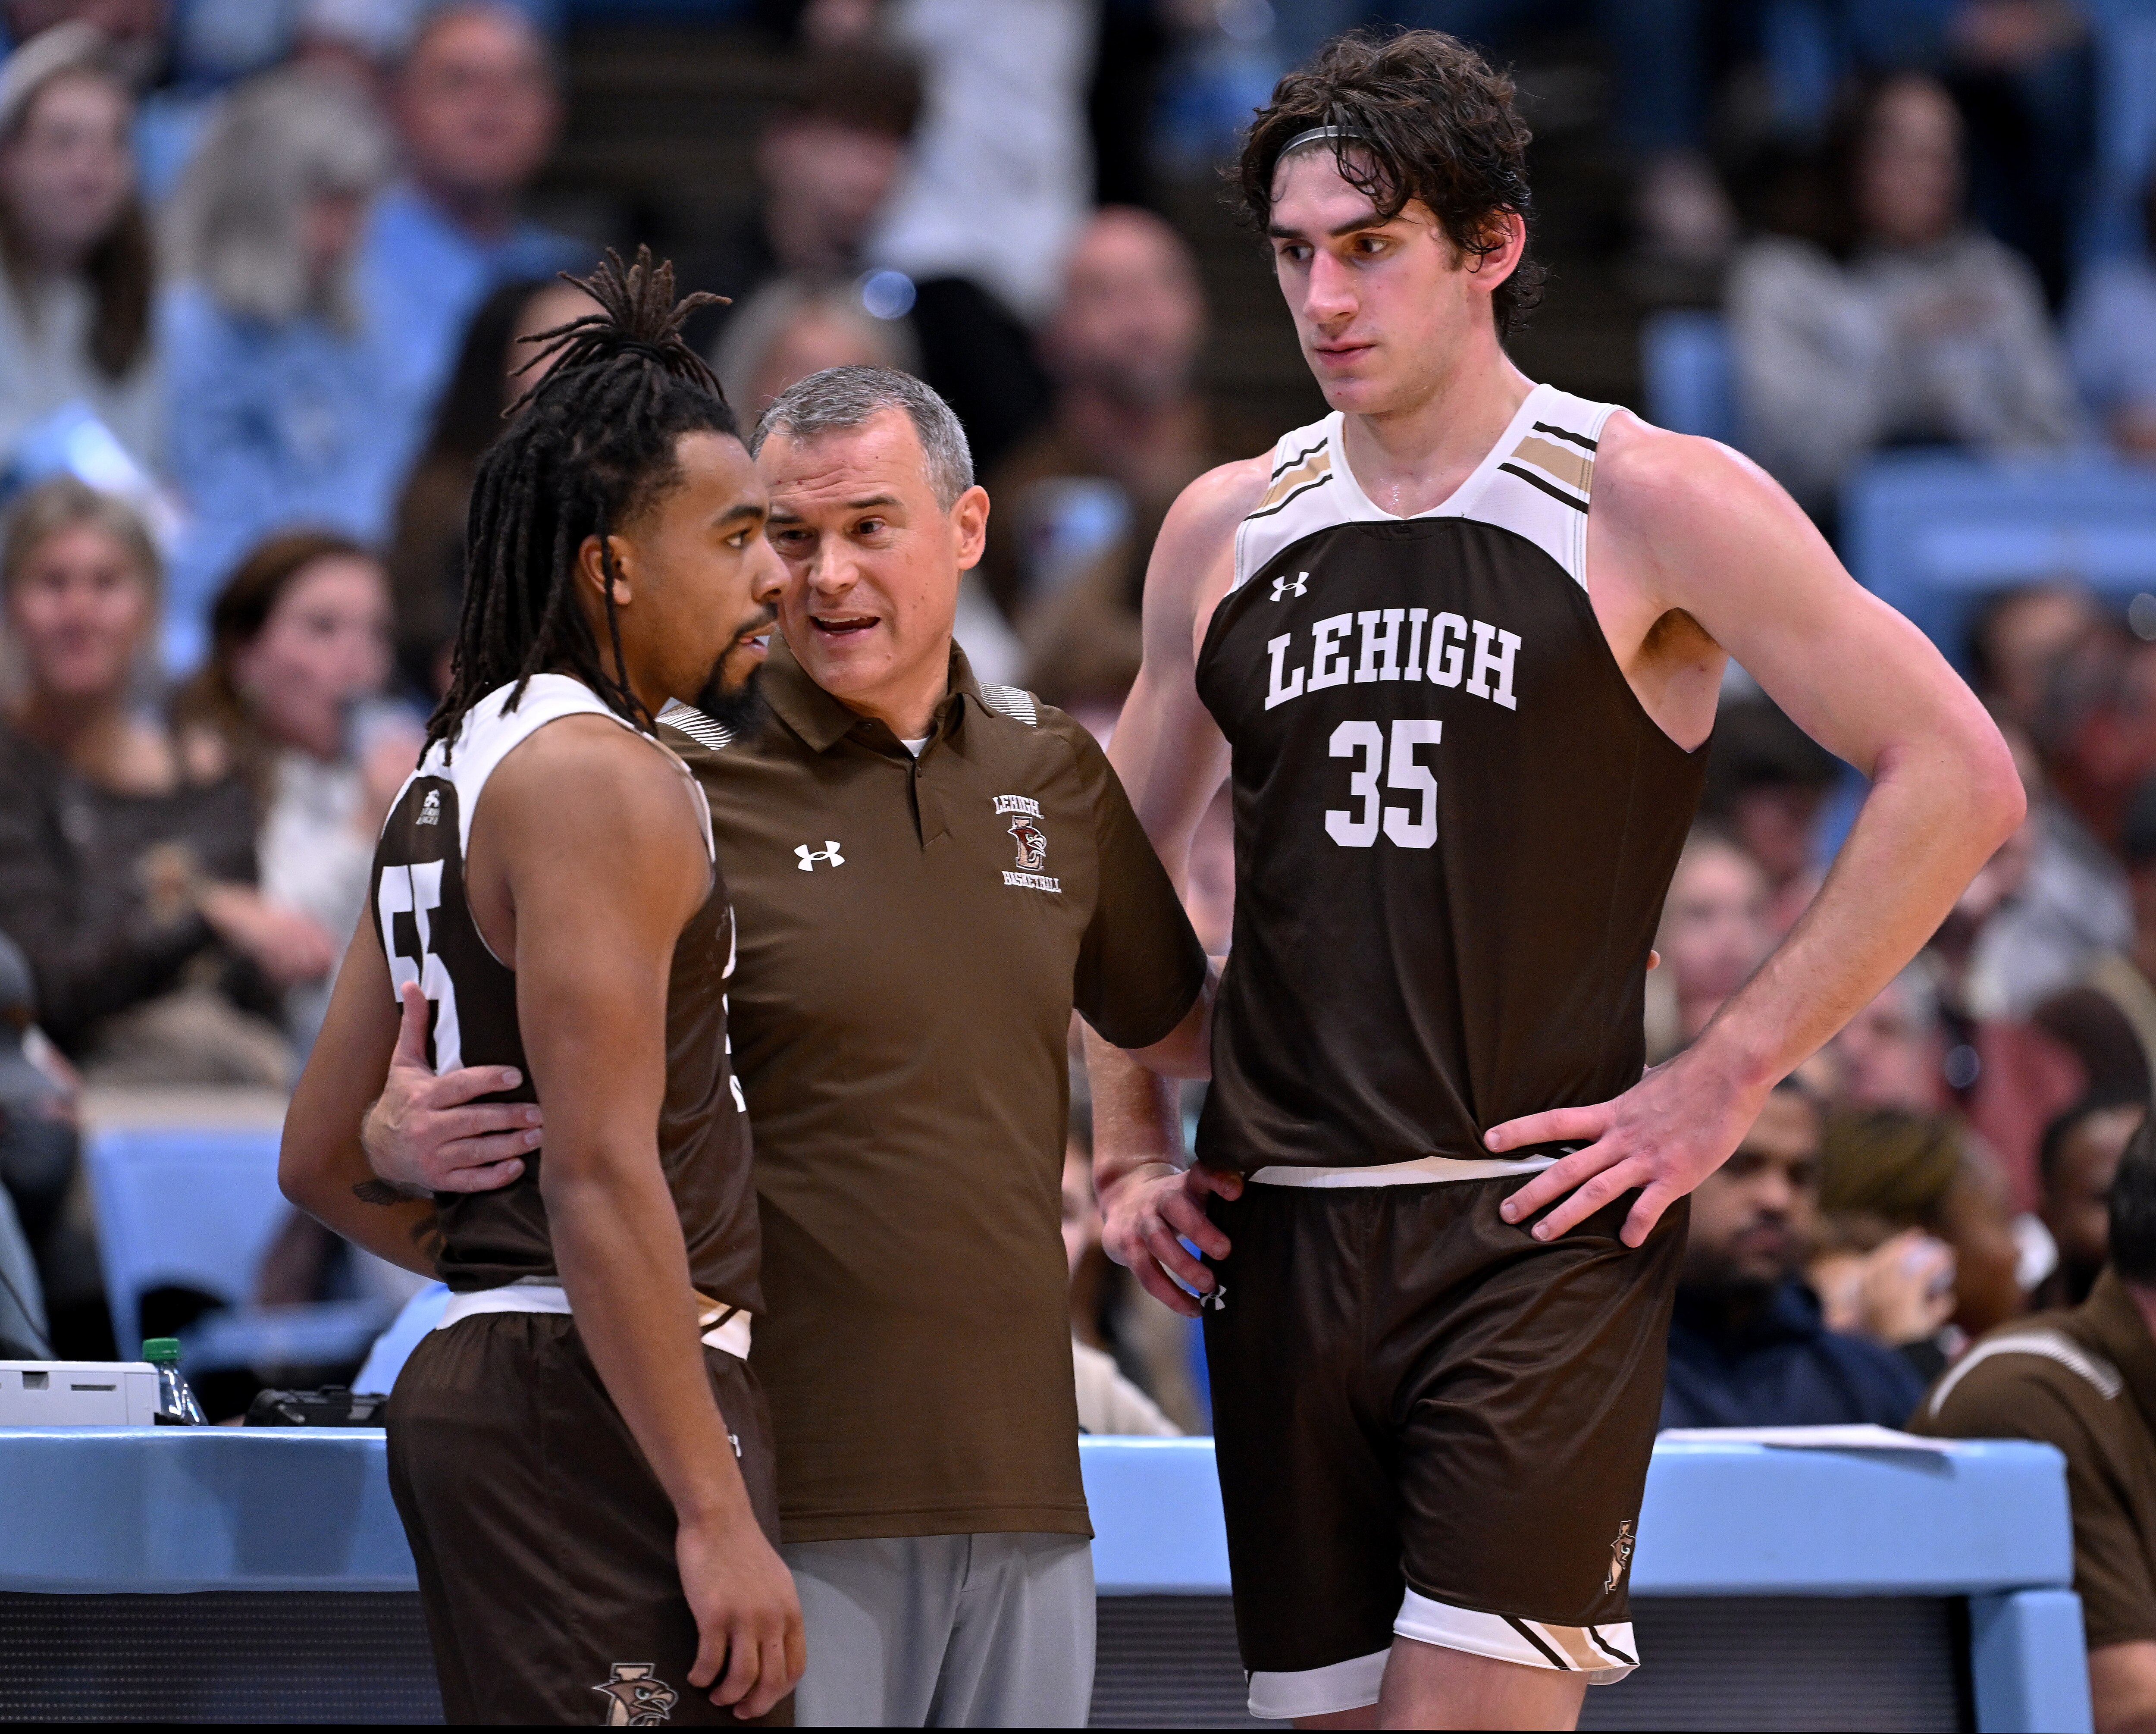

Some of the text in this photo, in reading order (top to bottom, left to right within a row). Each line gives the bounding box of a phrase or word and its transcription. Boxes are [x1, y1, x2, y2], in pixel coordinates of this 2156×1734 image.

[1264, 608, 1522, 711] LEHIGH
[992, 794, 1045, 819] LEHIGH
[1325, 719, 1443, 849] 35
